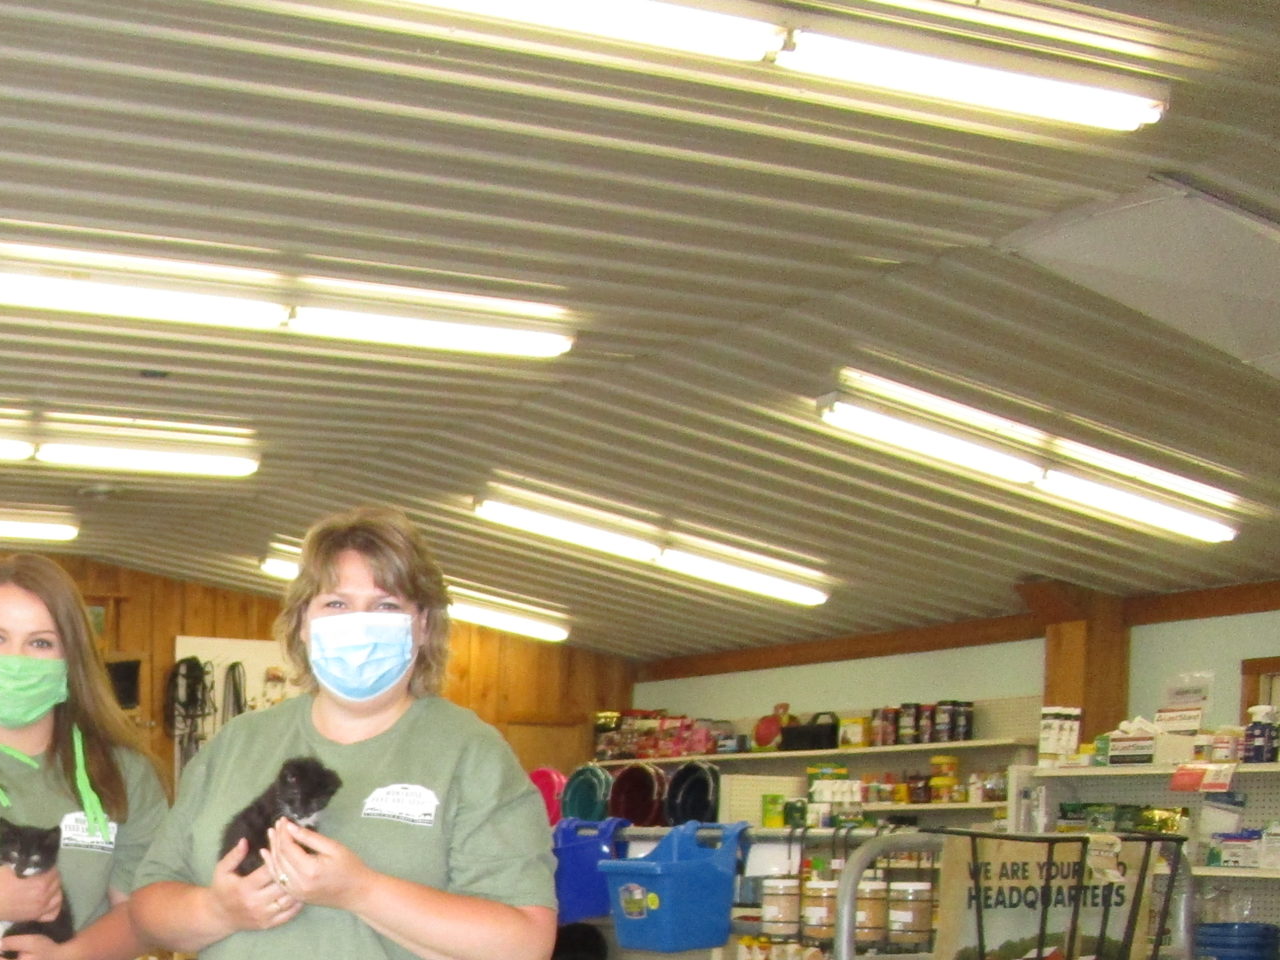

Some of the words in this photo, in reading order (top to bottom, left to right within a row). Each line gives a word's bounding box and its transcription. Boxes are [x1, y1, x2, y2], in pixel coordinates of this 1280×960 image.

[967, 861, 992, 880] WE
[998, 861, 1030, 881] ARE
[1035, 861, 1082, 881] YOUR
[967, 884, 1127, 910] HEADQUARTERS
